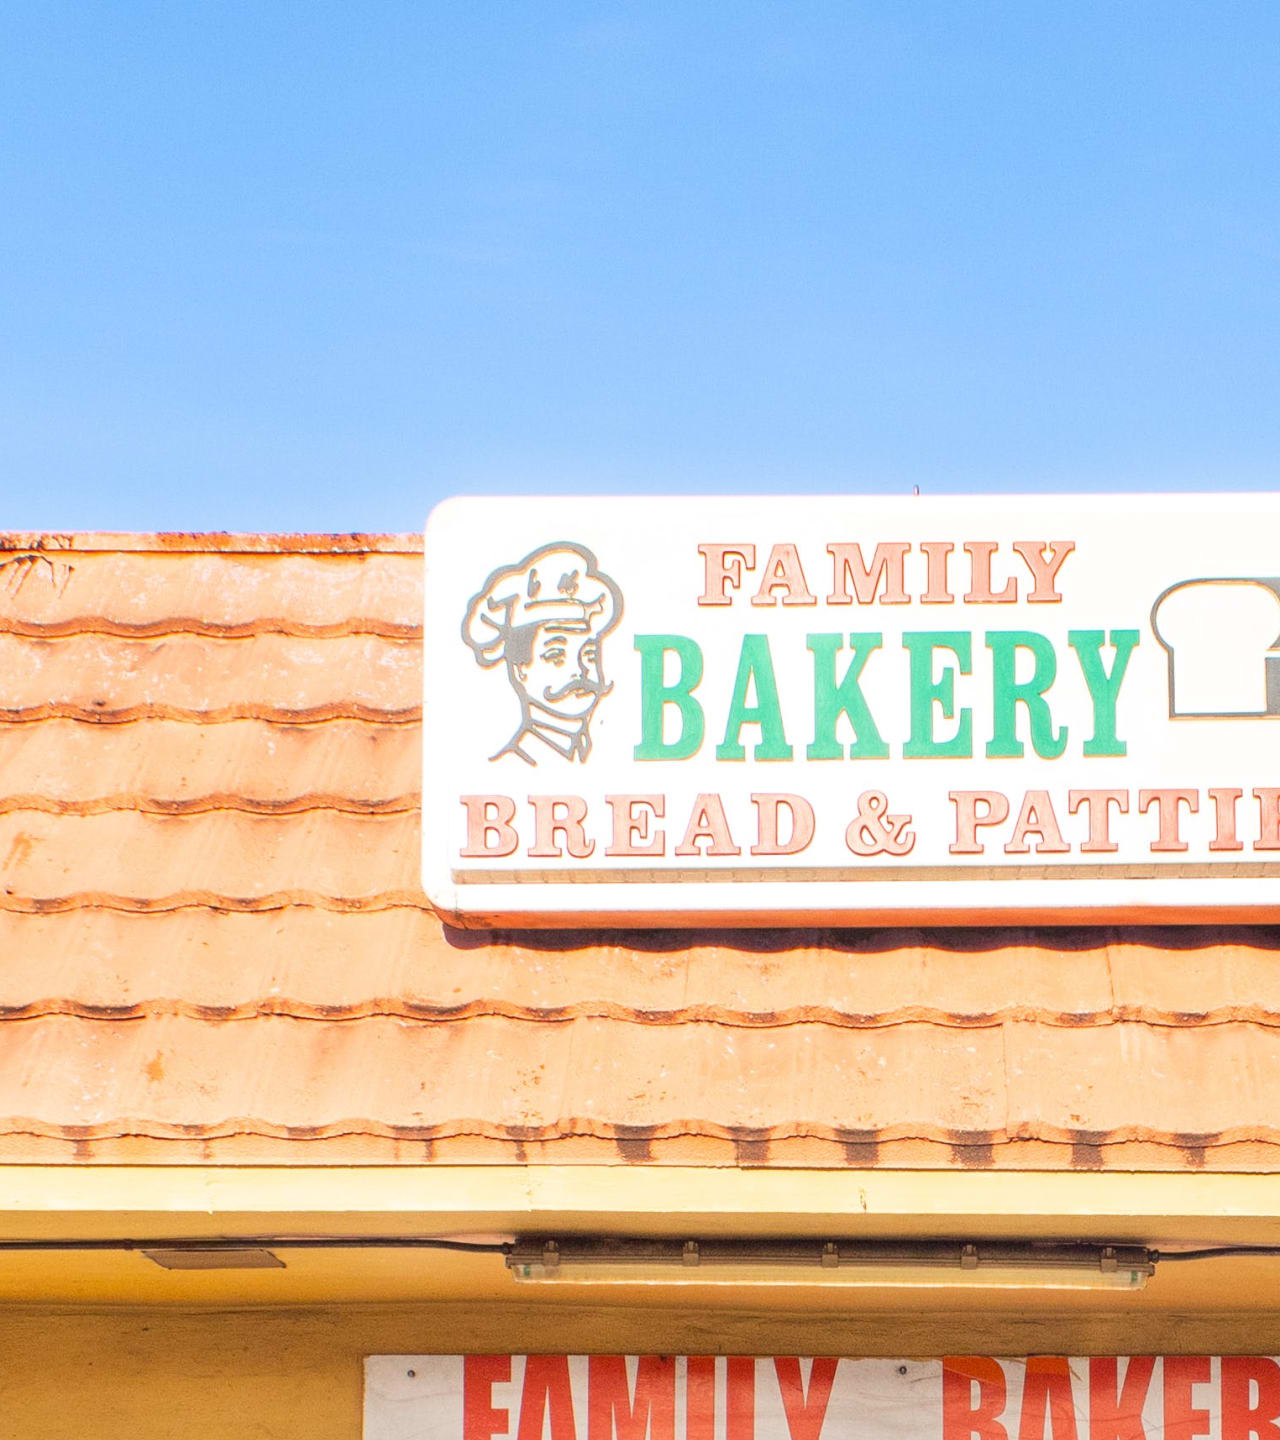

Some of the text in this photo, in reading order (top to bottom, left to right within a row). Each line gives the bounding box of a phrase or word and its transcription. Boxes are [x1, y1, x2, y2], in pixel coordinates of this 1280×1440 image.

[697, 542, 1076, 607] FAMILY
[632, 629, 1141, 761] BAKERY
[459, 792, 816, 859] BREAD
[846, 789, 916, 857] &
